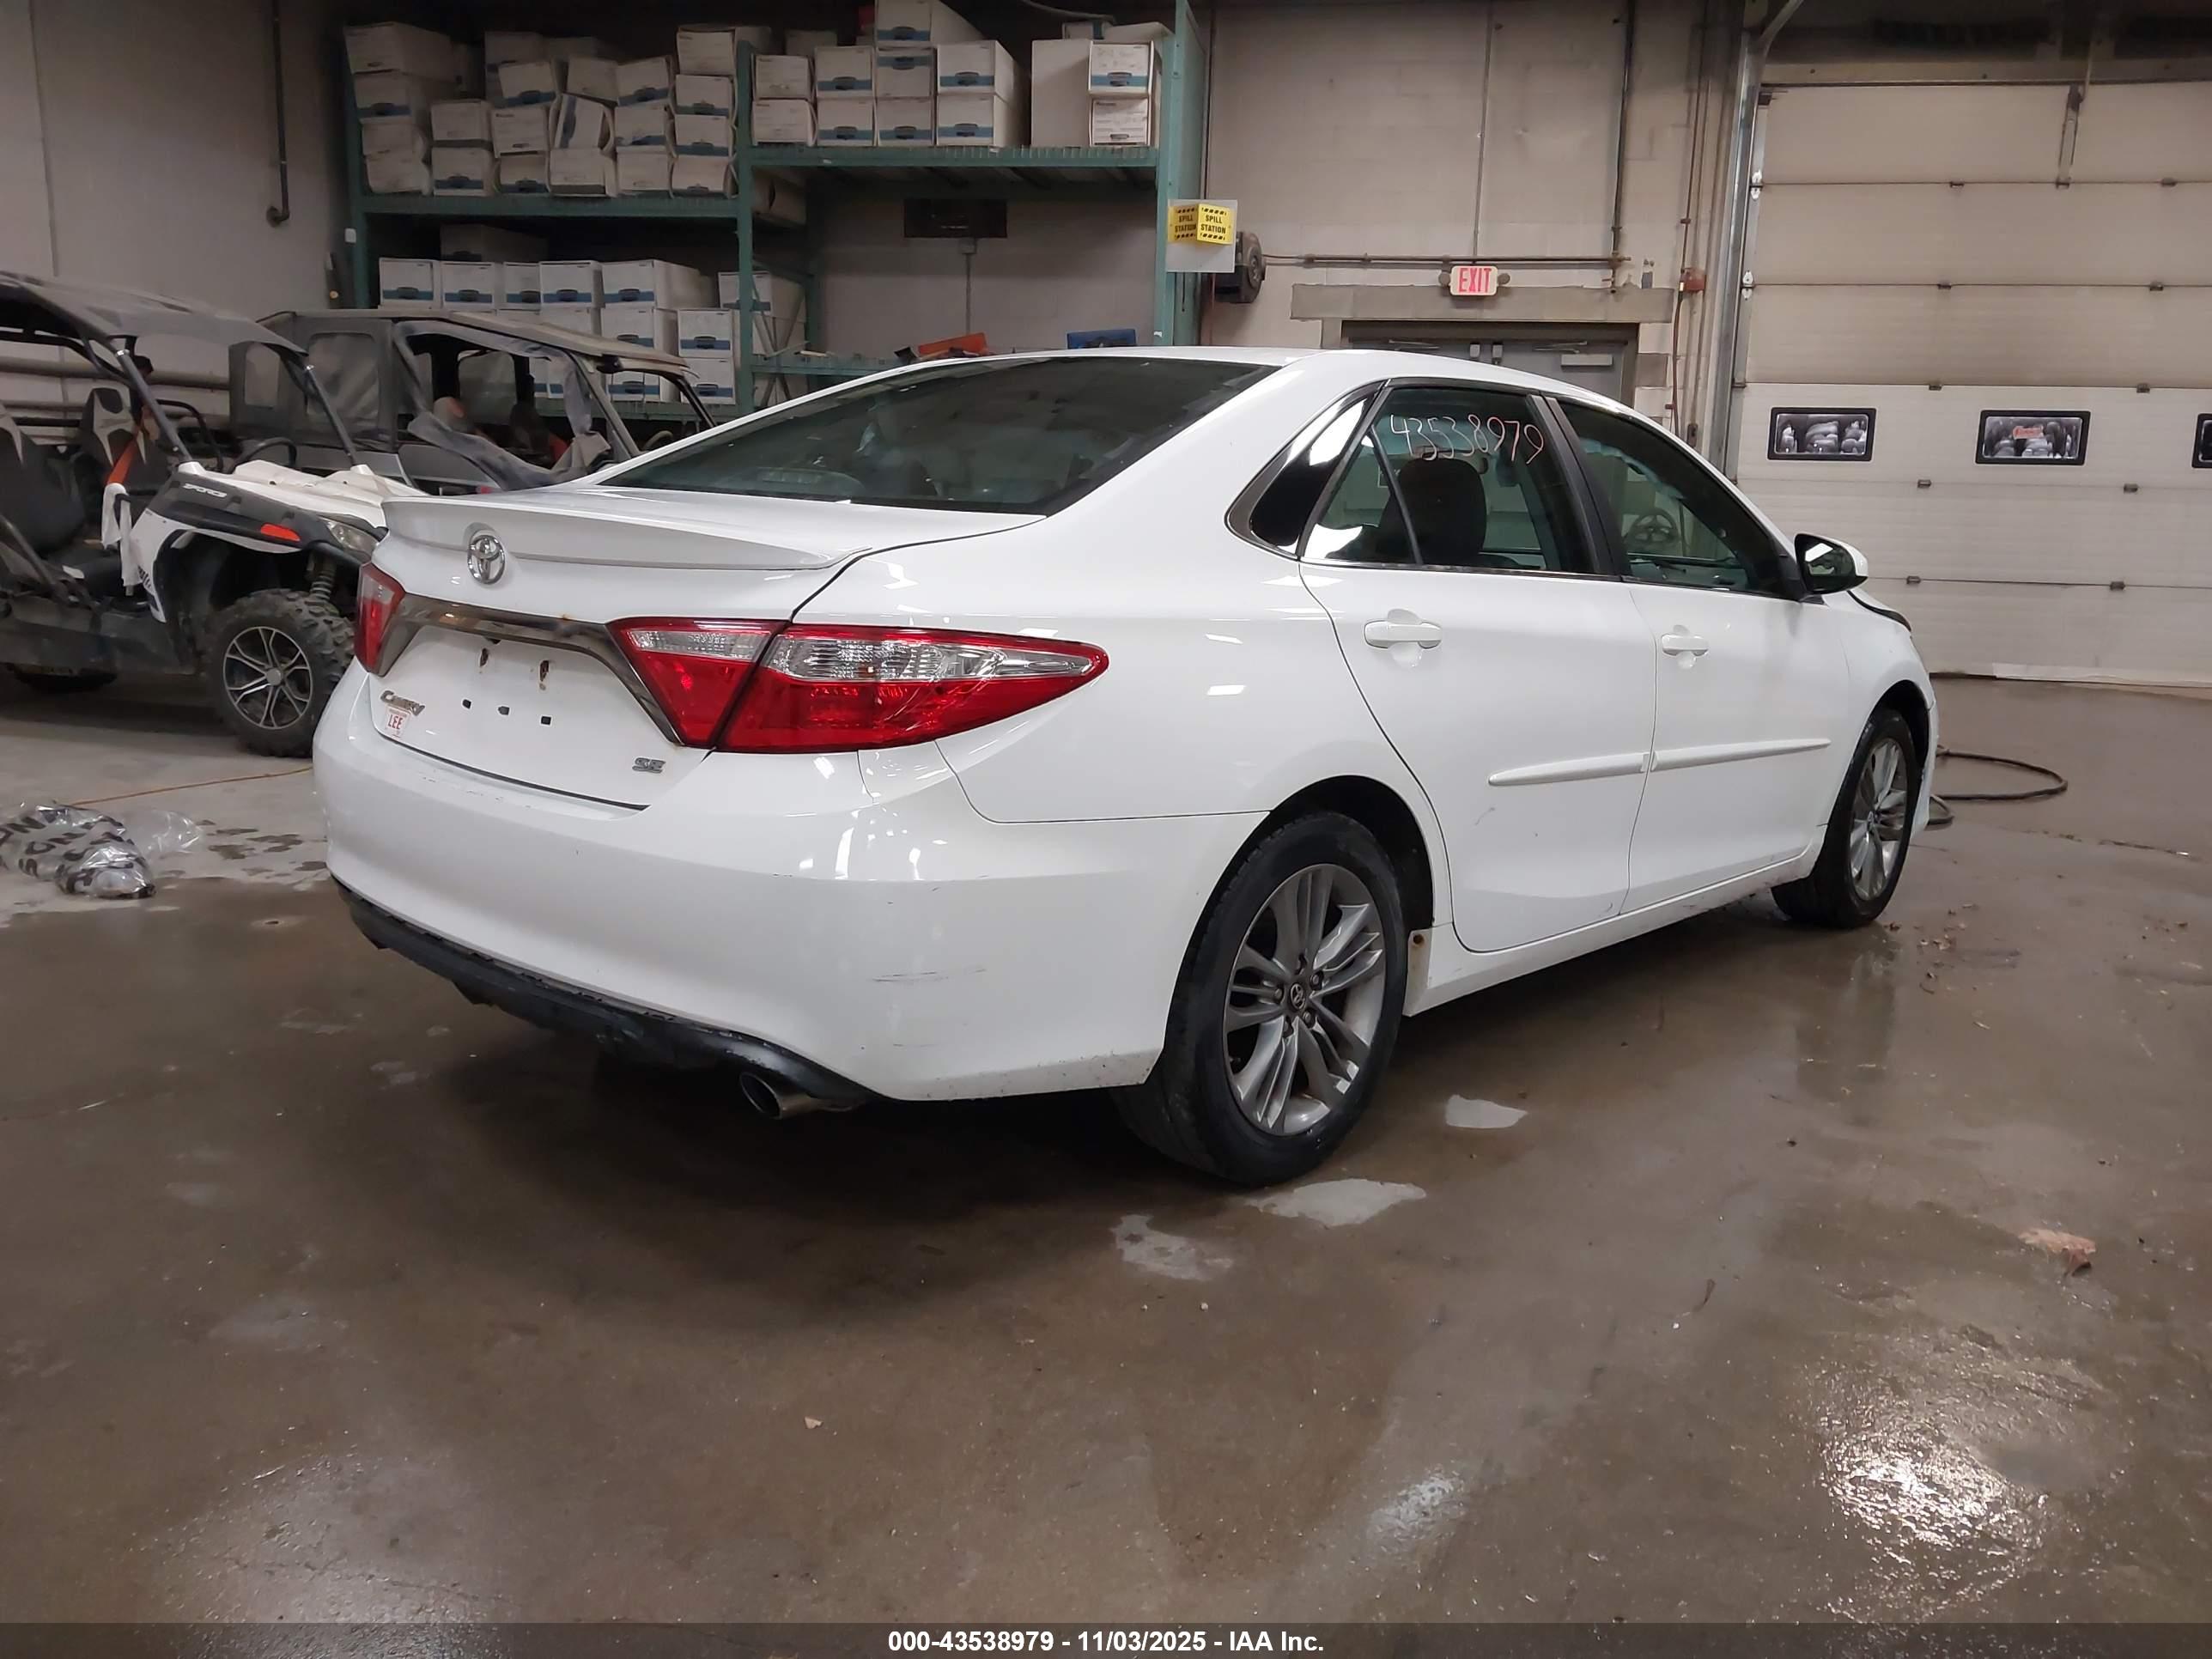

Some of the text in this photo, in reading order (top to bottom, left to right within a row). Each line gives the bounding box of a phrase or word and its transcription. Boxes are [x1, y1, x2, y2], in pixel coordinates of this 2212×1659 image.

[1205, 215, 1223, 223] SPILL
[1200, 223, 1226, 234] STATION
[1459, 267, 1492, 293] EXIT
[1390, 414, 1544, 465] 43538979
[388, 714, 404, 730] LEE
[632, 757, 666, 774] SE
